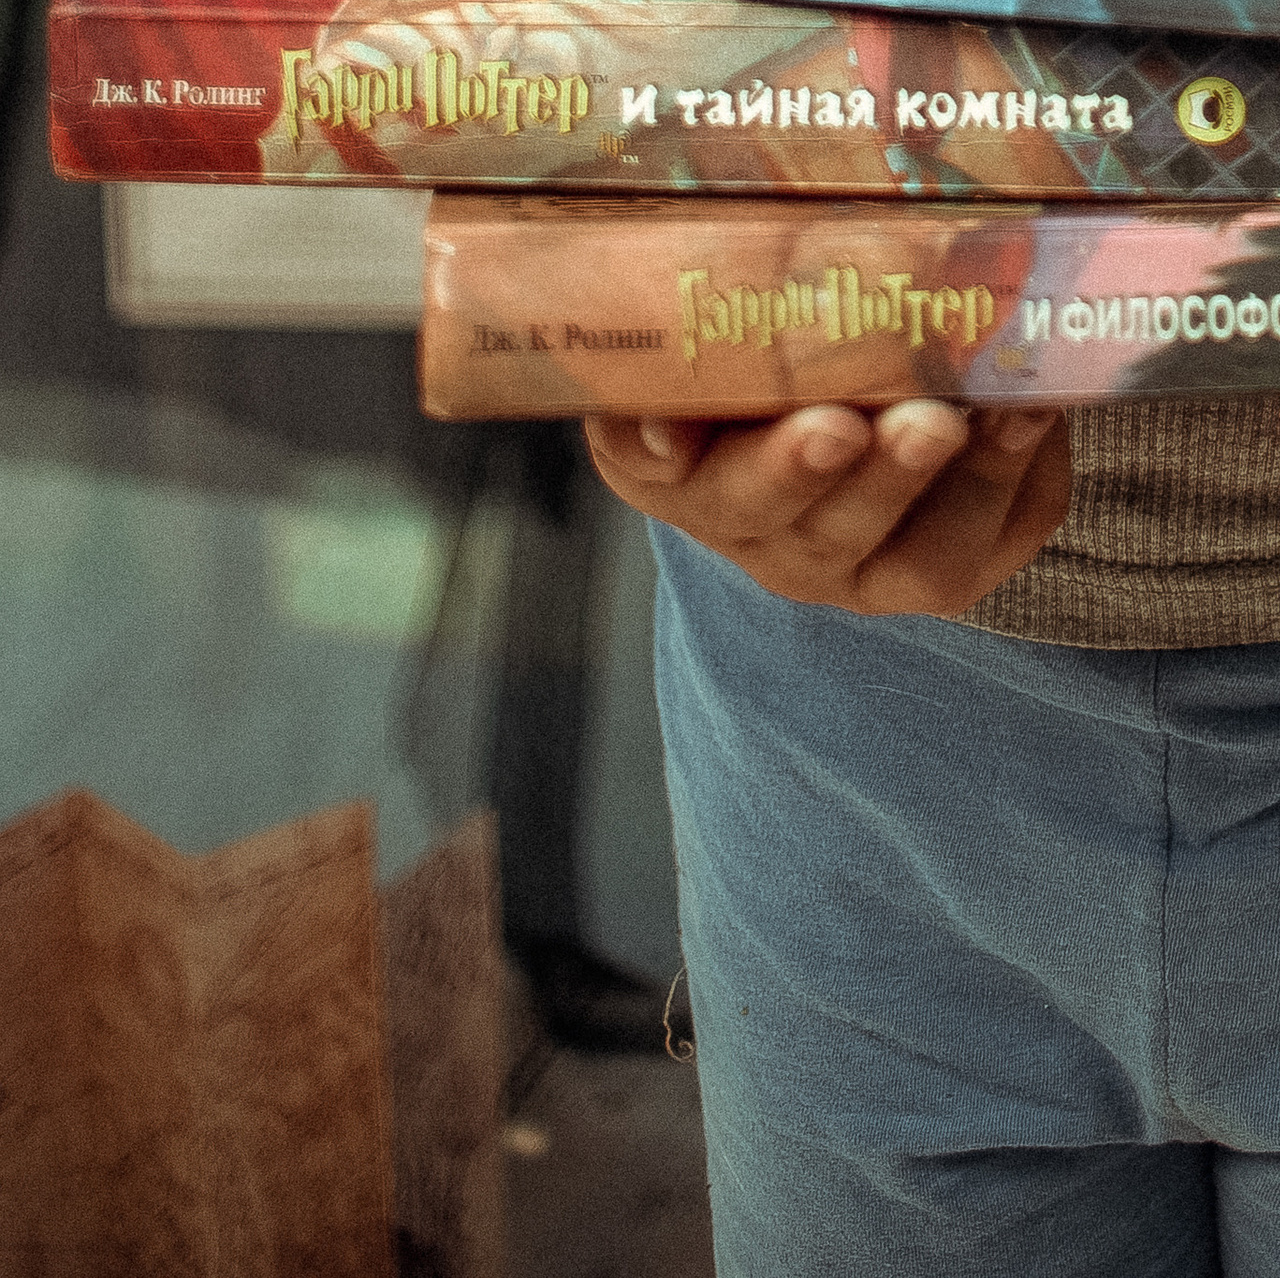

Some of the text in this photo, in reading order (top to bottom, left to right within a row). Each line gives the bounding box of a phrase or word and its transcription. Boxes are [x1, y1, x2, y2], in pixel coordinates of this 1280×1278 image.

[92, 77, 267, 109] Дж. К. Ролинг
[281, 48, 413, 155] Гарри
[675, 79, 877, 129] тайная
[896, 88, 1134, 134] комната
[677, 267, 815, 378] Гарри
